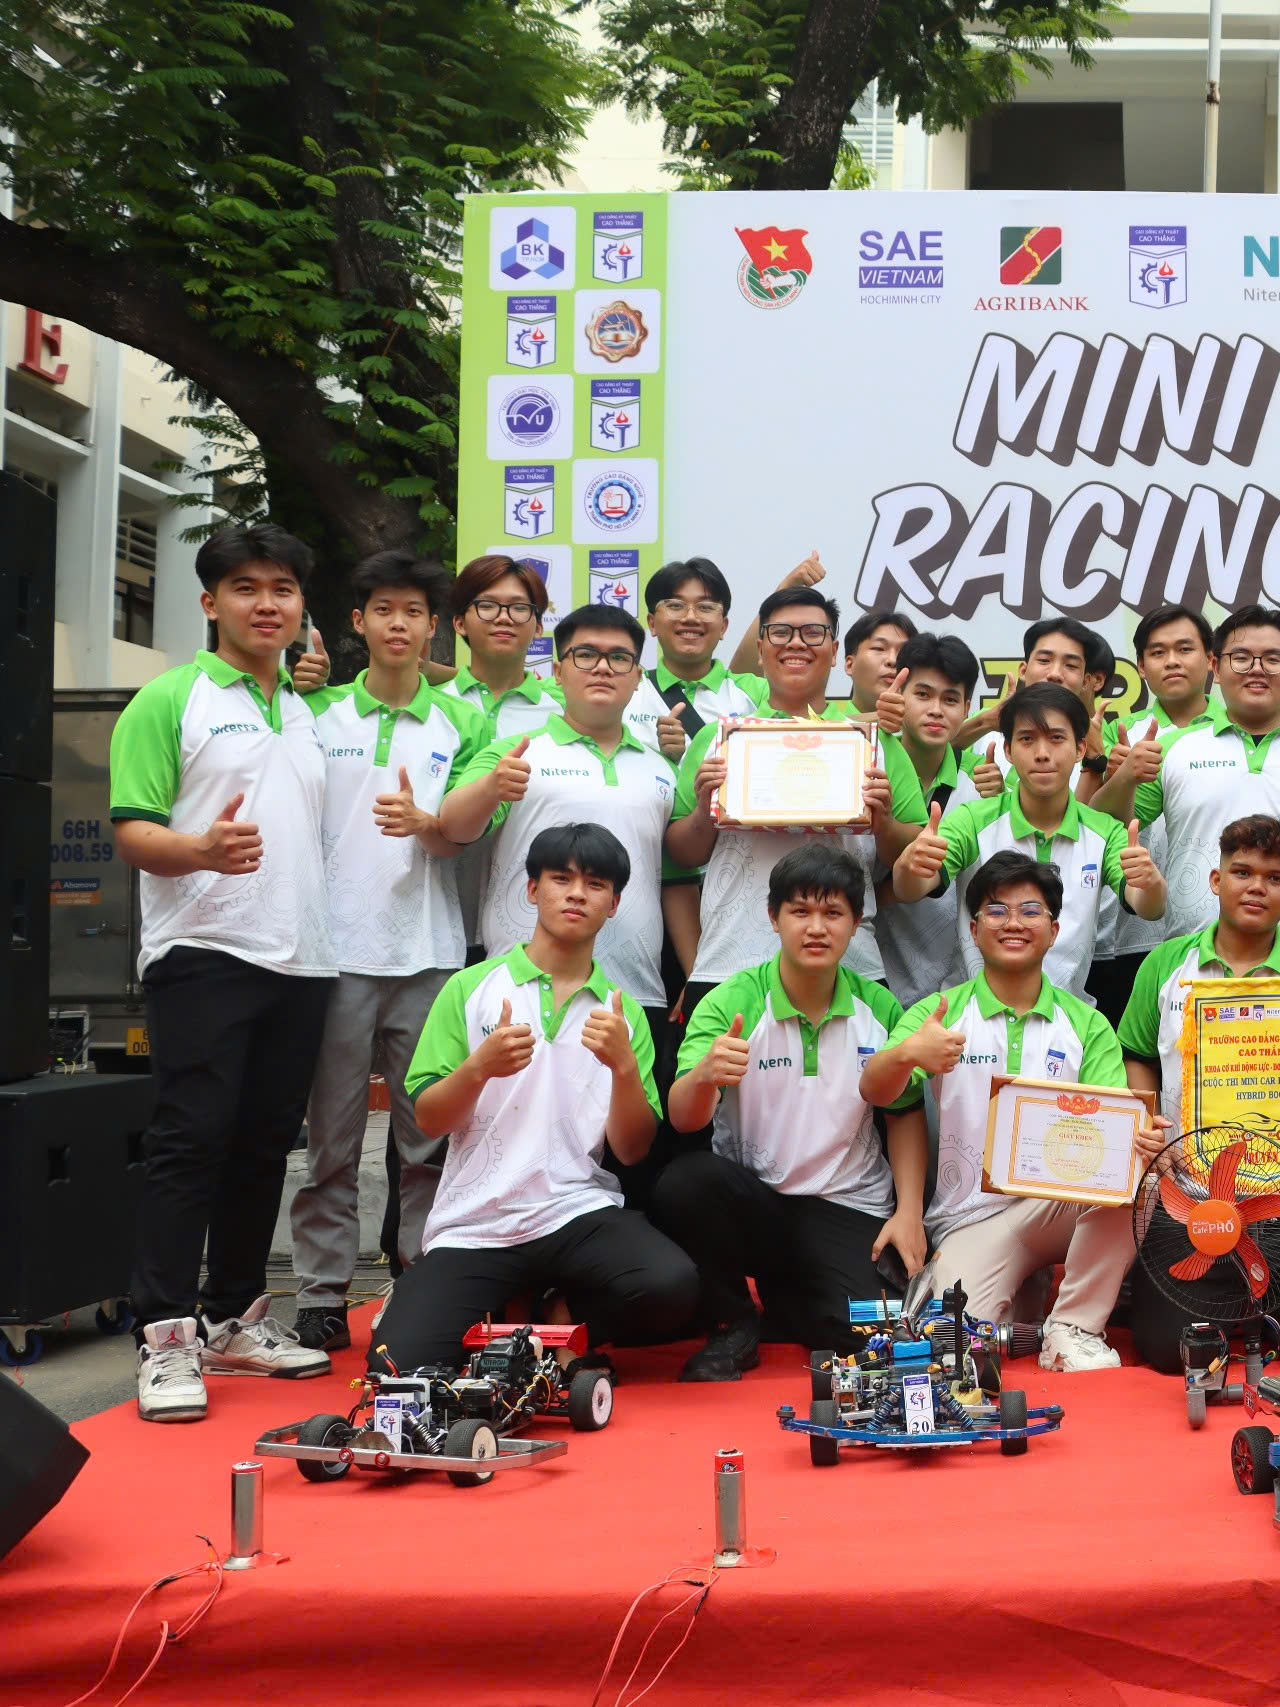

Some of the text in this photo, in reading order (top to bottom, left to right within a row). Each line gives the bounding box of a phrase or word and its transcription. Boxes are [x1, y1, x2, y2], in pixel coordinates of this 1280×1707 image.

[521, 244, 544, 256] BK
[858, 230, 944, 262] SAE
[860, 270, 943, 284] VIETNAM
[860, 296, 941, 304] HOCHIMINH CITY
[974, 296, 1090, 311] AGRIBANK
[328, 747, 364, 758] iterra
[1190, 760, 1236, 770] Niterra
[540, 768, 590, 777] Niterra
[63, 820, 100, 840] 66H
[64, 881, 97, 889] Ahamove
[1208, 1034, 1240, 1044] TRƯỜNG
[1241, 1035, 1258, 1044] CAO
[1238, 1048, 1258, 1056] CAO
[1204, 1065, 1221, 1073] KHOA
[1202, 1078, 1224, 1088] CUỘC
[1225, 1078, 1238, 1086] THI
[1240, 1078, 1258, 1086] MINI
[1260, 1077, 1276, 1085] CAR
[1236, 1091, 1266, 1100] HYBRID
[1208, 1218, 1235, 1234] PHỐ
